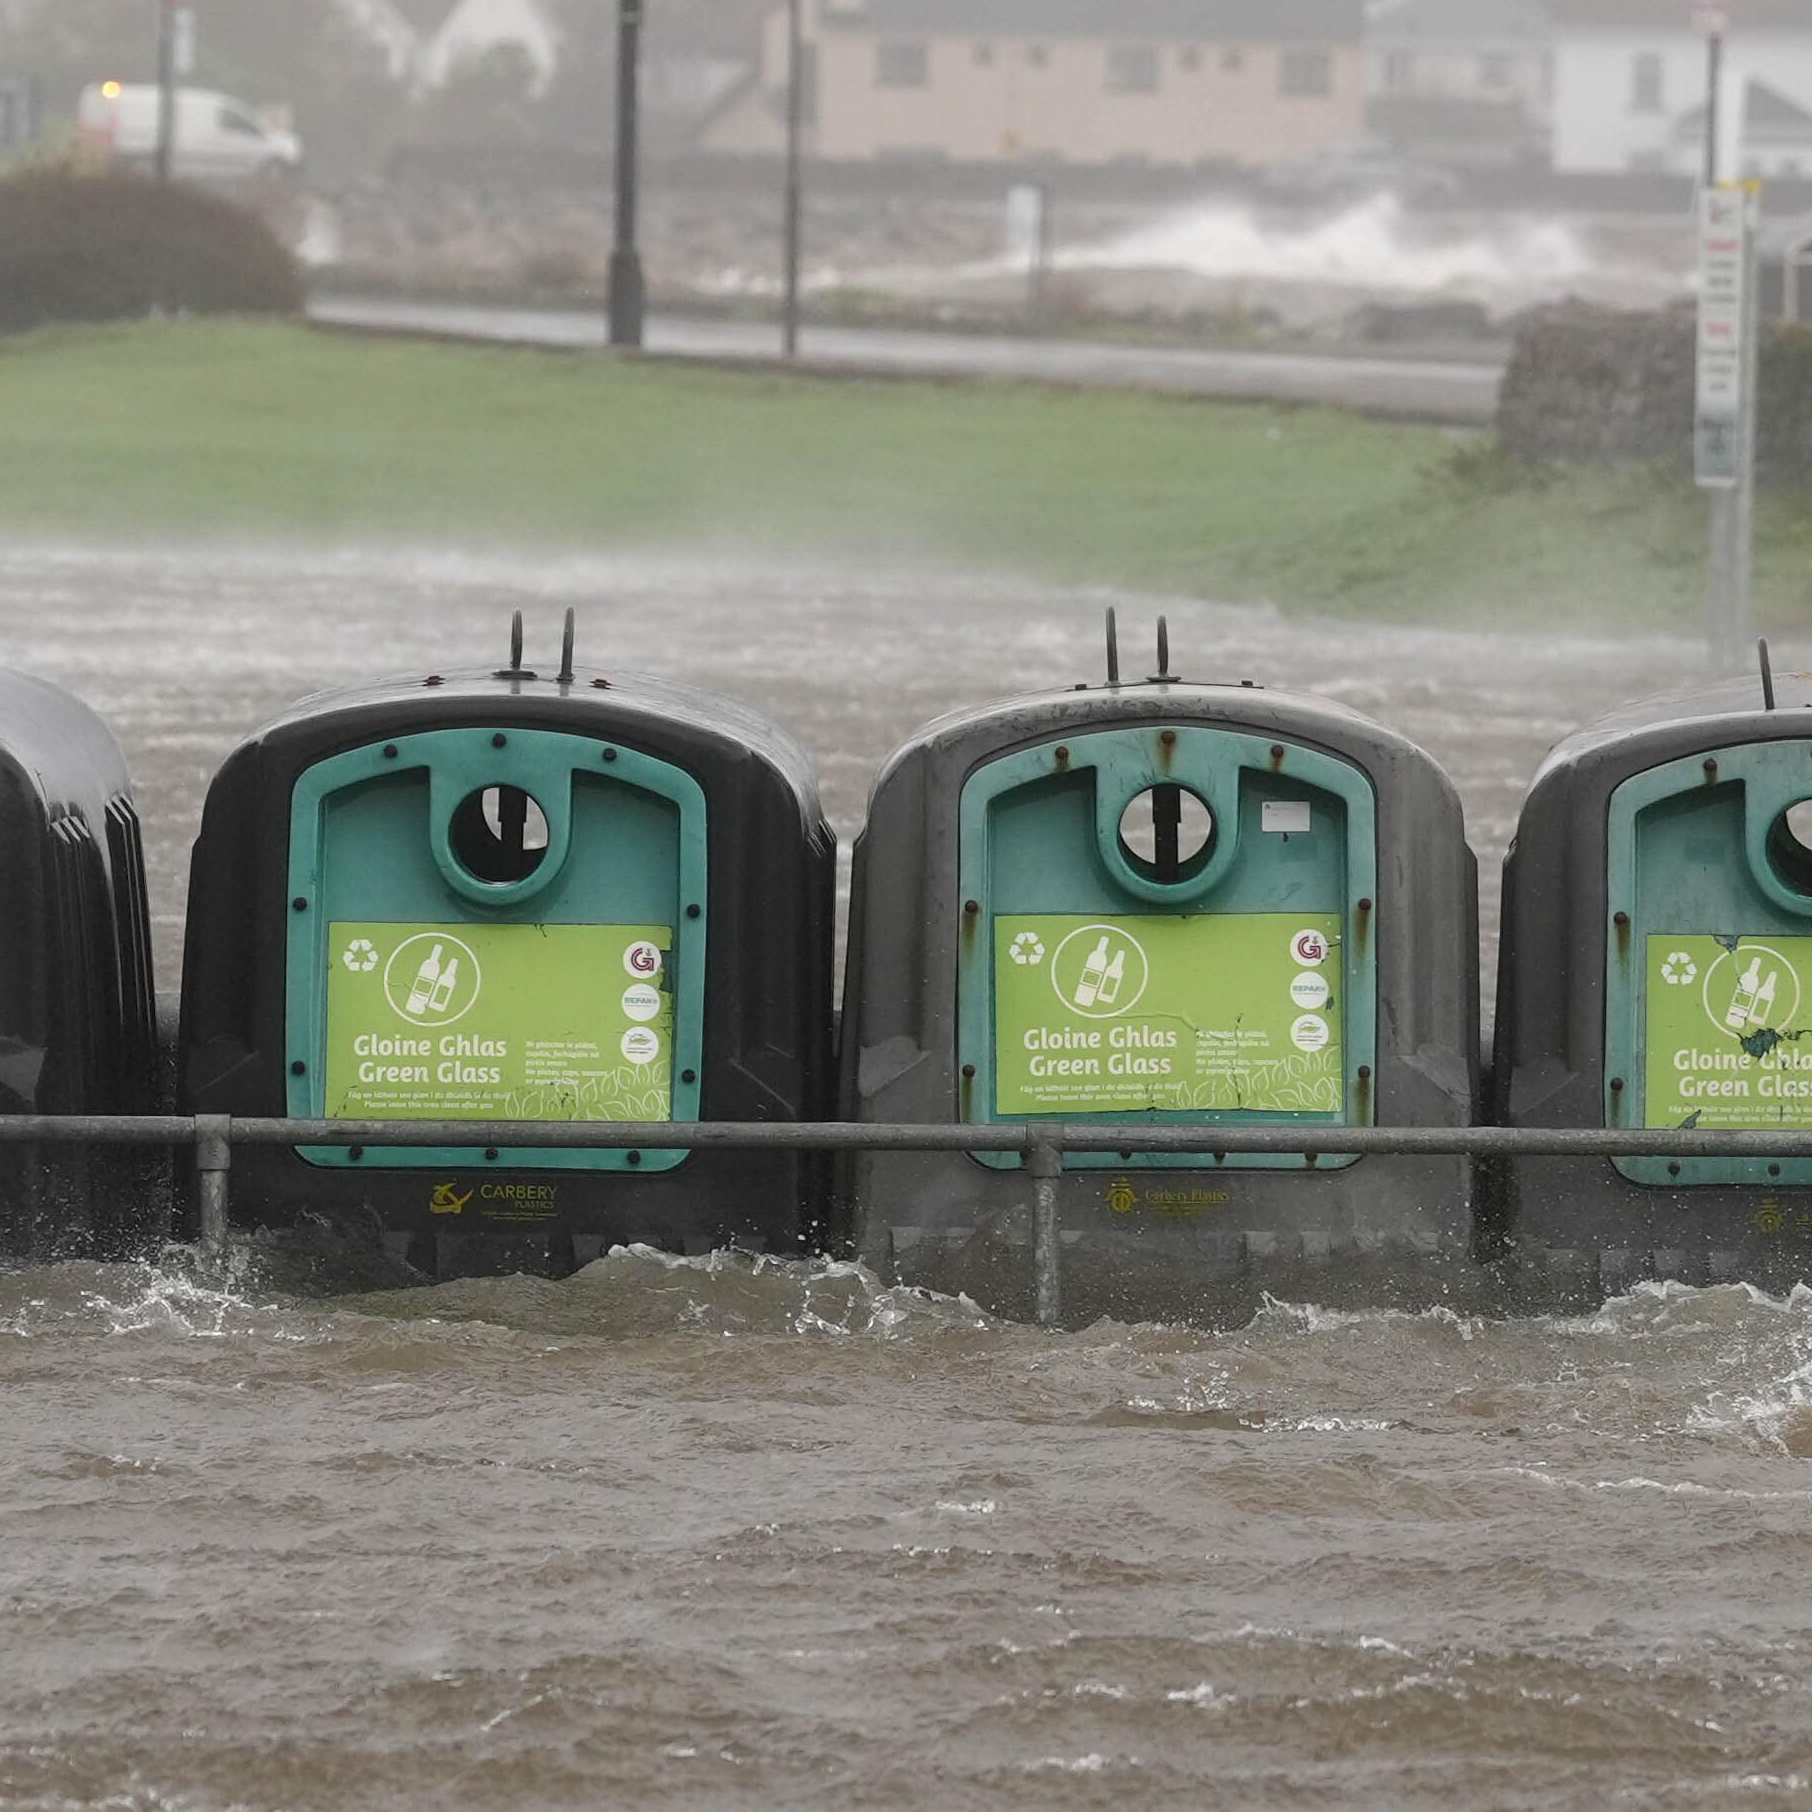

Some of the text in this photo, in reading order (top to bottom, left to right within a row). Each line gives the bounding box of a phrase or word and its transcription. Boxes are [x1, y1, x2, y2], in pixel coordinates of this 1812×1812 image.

[353, 1034, 508, 1057] Gloine Ghlas
[1023, 1025, 1177, 1050] Gloine Ghlas
[1029, 1055, 1100, 1077] Green
[1107, 1052, 1172, 1075] Glass
[1673, 1048, 1751, 1070] Gloine
[358, 1061, 429, 1083] Green
[437, 1060, 501, 1083] Glass
[1678, 1076, 1750, 1097] Green
[480, 1184, 557, 1200] CARBERY
[514, 1201, 554, 1209] PLASTICS
